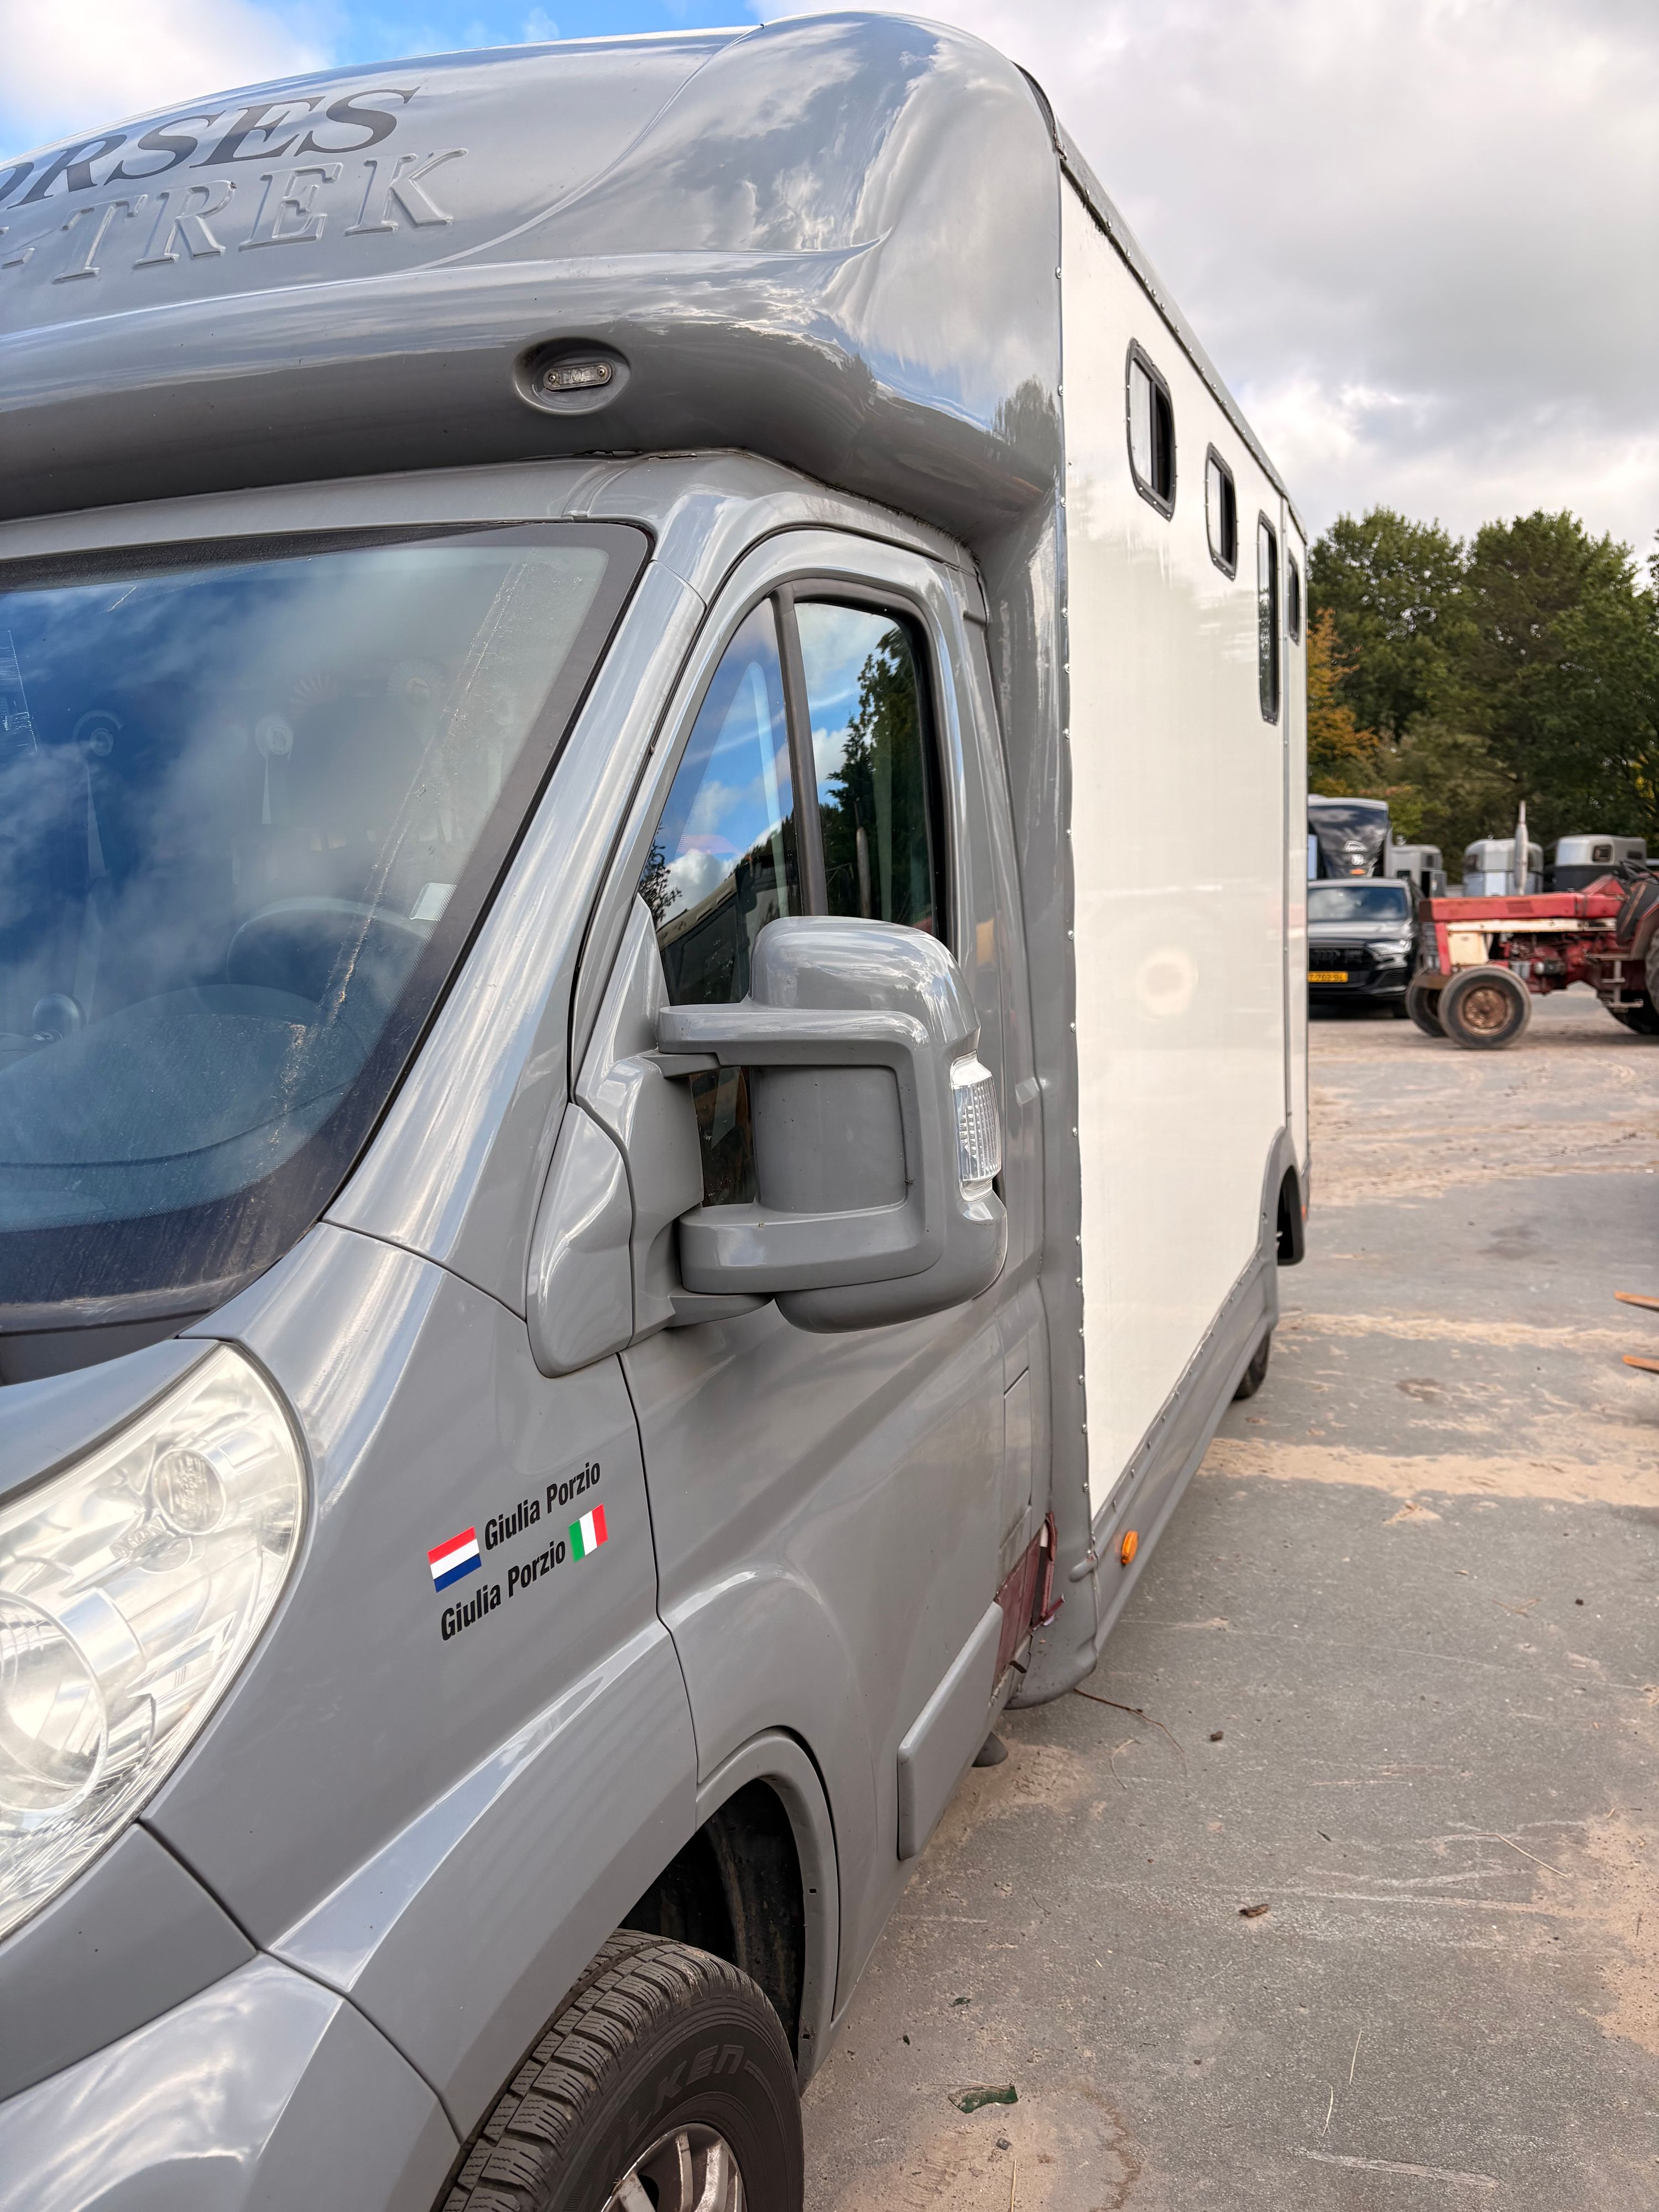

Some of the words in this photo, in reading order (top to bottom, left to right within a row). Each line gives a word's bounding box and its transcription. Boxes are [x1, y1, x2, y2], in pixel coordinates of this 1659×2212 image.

[484, 1499, 541, 1551] Giulia
[546, 1462, 601, 1514] Porzio
[441, 1584, 502, 1641] Giulia
[507, 1540, 566, 1598] Porzio
